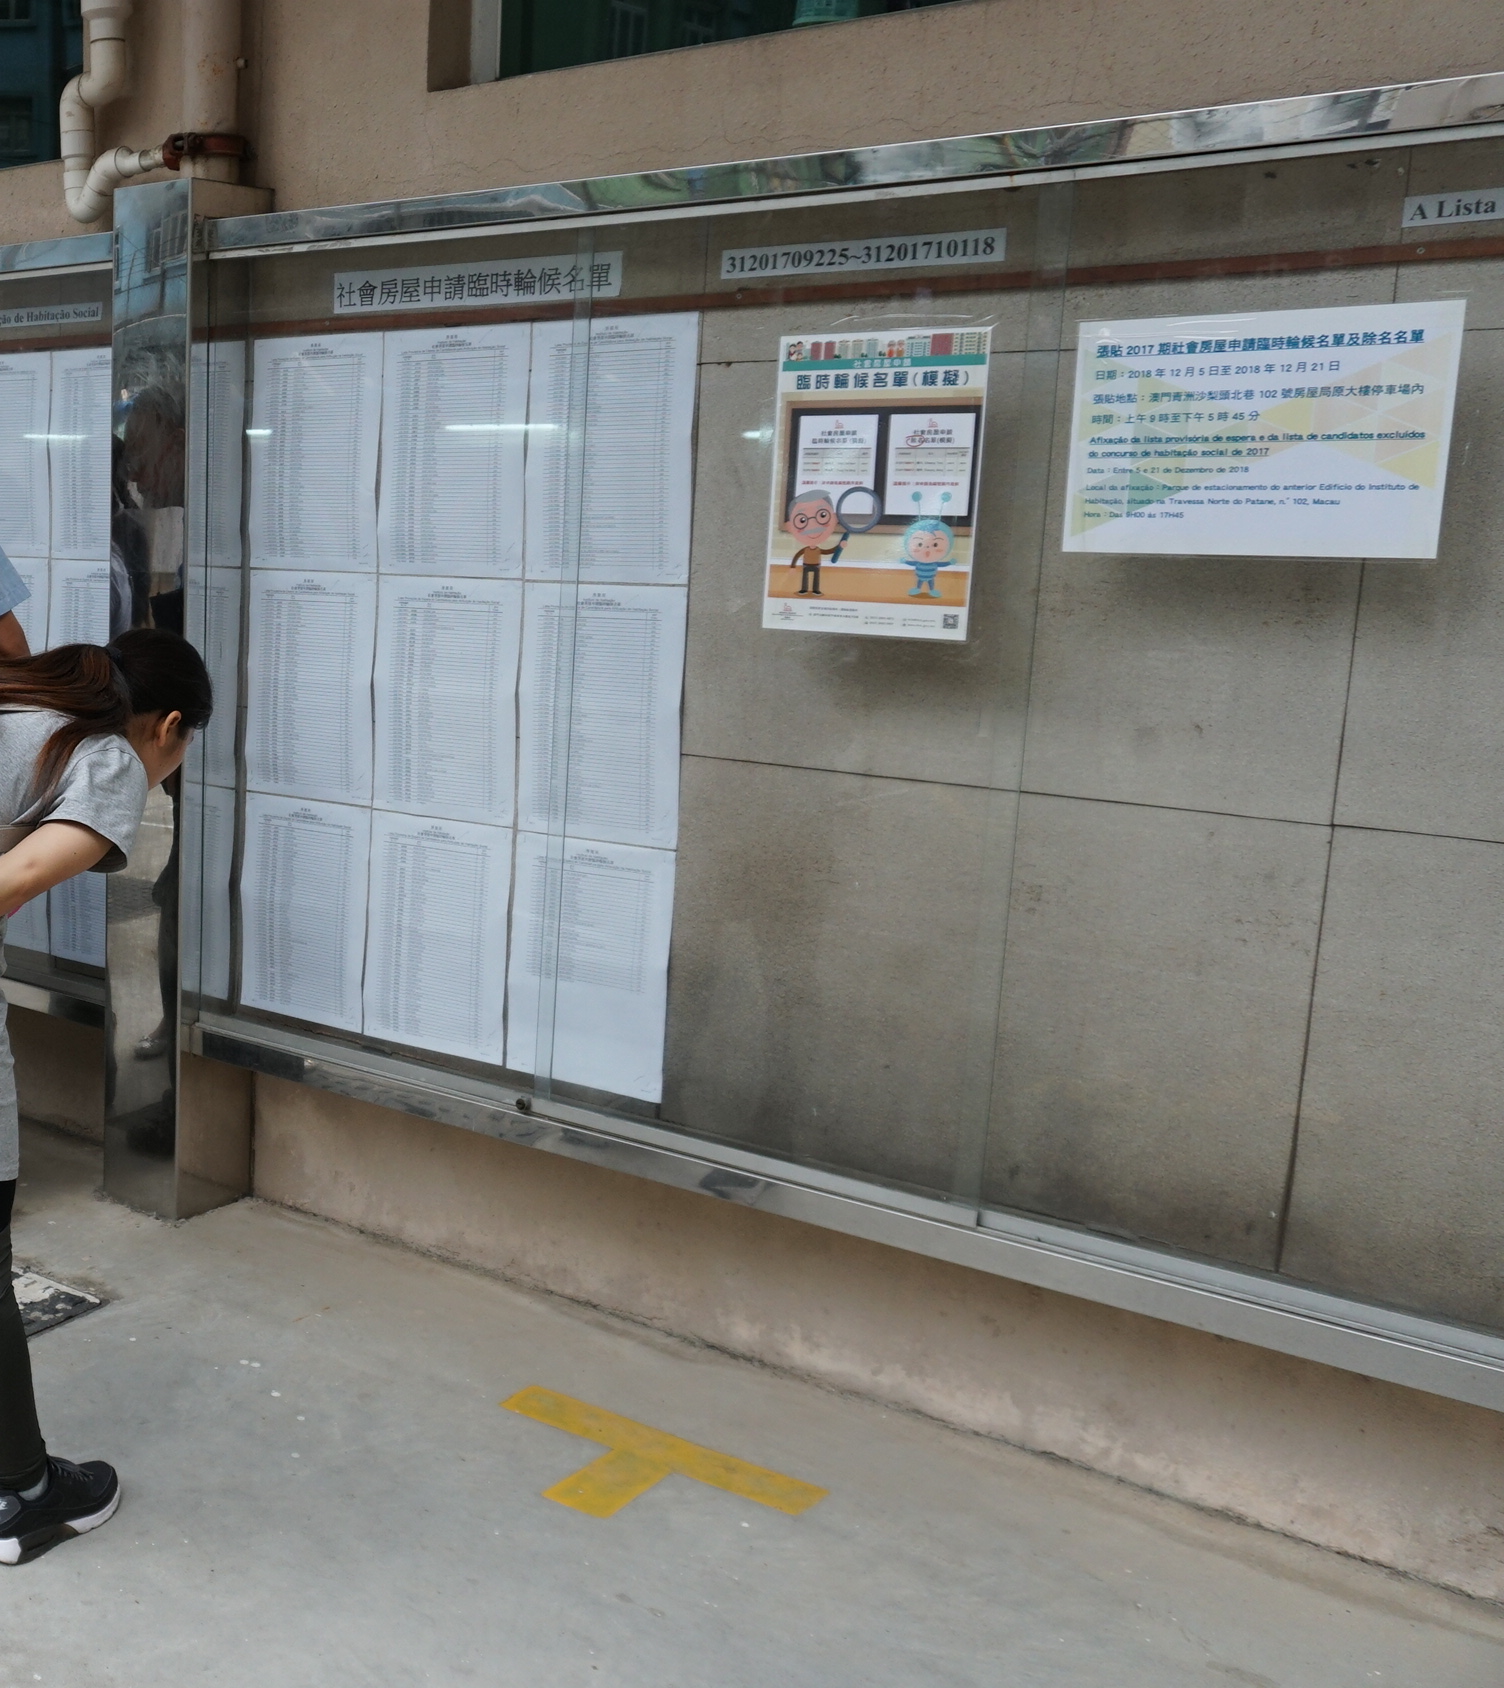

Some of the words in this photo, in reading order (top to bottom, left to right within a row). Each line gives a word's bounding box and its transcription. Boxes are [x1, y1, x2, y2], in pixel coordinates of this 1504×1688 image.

[1410, 203, 1428, 220] A
[1436, 199, 1496, 218] Lista
[336, 262, 612, 308] 社會房屋申請臨時輪候名單
[14, 312, 24, 323] de
[26, 309, 70, 323] Habitação
[72, 306, 99, 318] Social
[1096, 344, 1123, 358] 張貼
[1126, 344, 1154, 355] 2017
[1158, 329, 1424, 355] 期社會房屋申請臨時輪候名單及除名名單
[1155, 368, 1166, 378] 年
[1170, 368, 1181, 377] 12
[1184, 366, 1195, 378] 月
[1198, 367, 1205, 376] 5
[1208, 365, 1232, 376] 日至
[1235, 365, 1260, 374] 2018
[1264, 363, 1275, 373] 年
[1280, 364, 1292, 372] 12
[1296, 361, 1307, 372] 月
[1311, 363, 1324, 371] 21
[1329, 360, 1340, 371] 日
[1259, 389, 1277, 398] 102
[1149, 414, 1156, 422] 9
[1158, 412, 1204, 423] 時至下午
[1207, 413, 1214, 421] 5
[1217, 411, 1229, 421] 時
[1232, 412, 1245, 420] 45
[1248, 410, 1260, 421] 分
[1143, 435, 1163, 443] lista
[1165, 434, 1209, 444] provisória
[1212, 434, 1223, 442] de
[1225, 434, 1256, 444] espera
[1268, 433, 1279, 441] da
[1282, 433, 1303, 441] lista
[1321, 432, 1374, 440] candidatos
[1376, 430, 1425, 439] excluídos
[1154, 449, 1198, 458] habitação
[1201, 448, 1228, 456] social
[1231, 448, 1243, 456] de
[1246, 447, 1269, 455] 2017
[1246, 498, 1276, 506] Patane,
[1293, 498, 1309, 506] 102,
